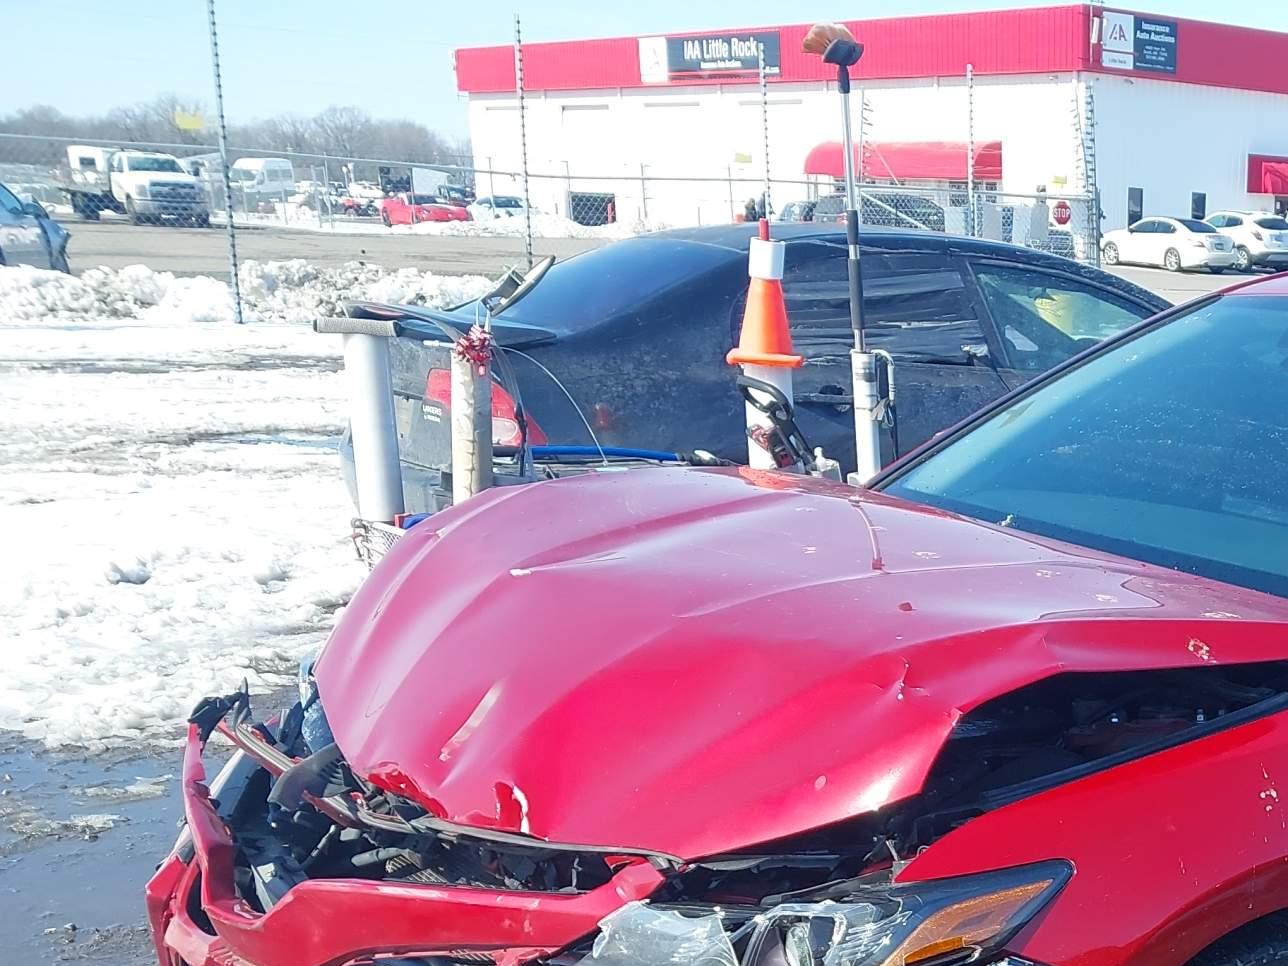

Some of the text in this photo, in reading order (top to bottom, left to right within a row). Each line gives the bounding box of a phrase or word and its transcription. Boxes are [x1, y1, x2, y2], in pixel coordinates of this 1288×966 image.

[1136, 31, 1149, 40] Auto
[684, 37, 758, 59] IAA Little Rock
[1053, 207, 1071, 218] STOP
